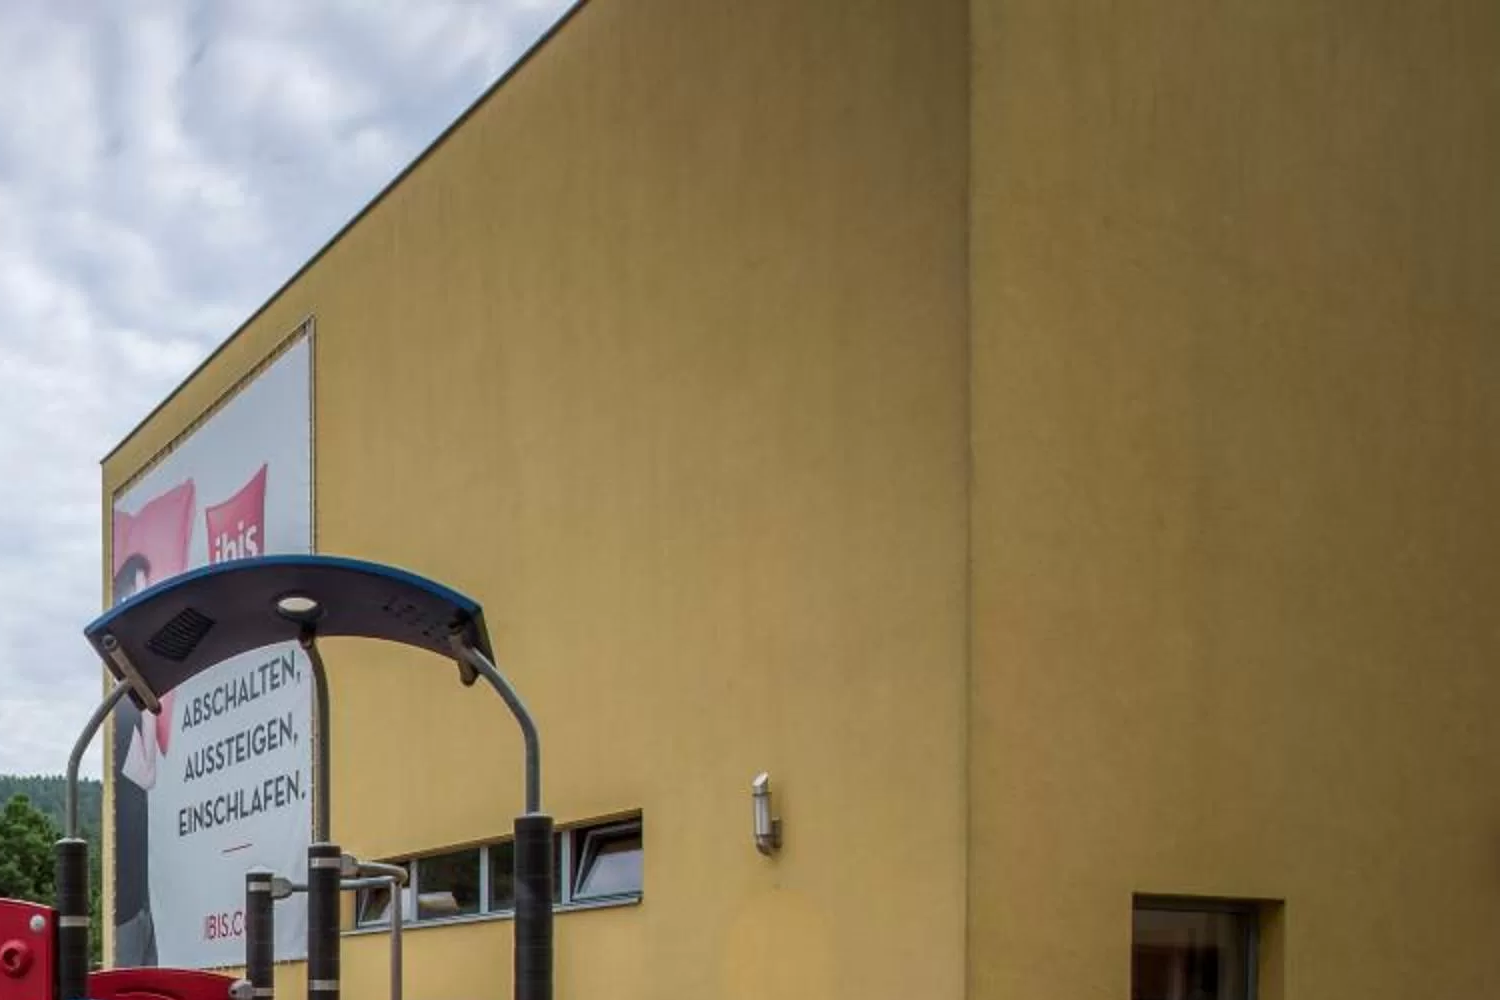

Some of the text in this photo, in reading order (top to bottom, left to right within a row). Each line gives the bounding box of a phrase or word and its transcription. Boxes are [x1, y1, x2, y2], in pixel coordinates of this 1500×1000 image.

[181, 649, 301, 733] ABSCHALTEN,
[183, 711, 299, 783] AUSSTEIGEN,
[179, 770, 306, 837] EINSCHLAFEN.
[204, 911, 247, 940] IBIS.C
